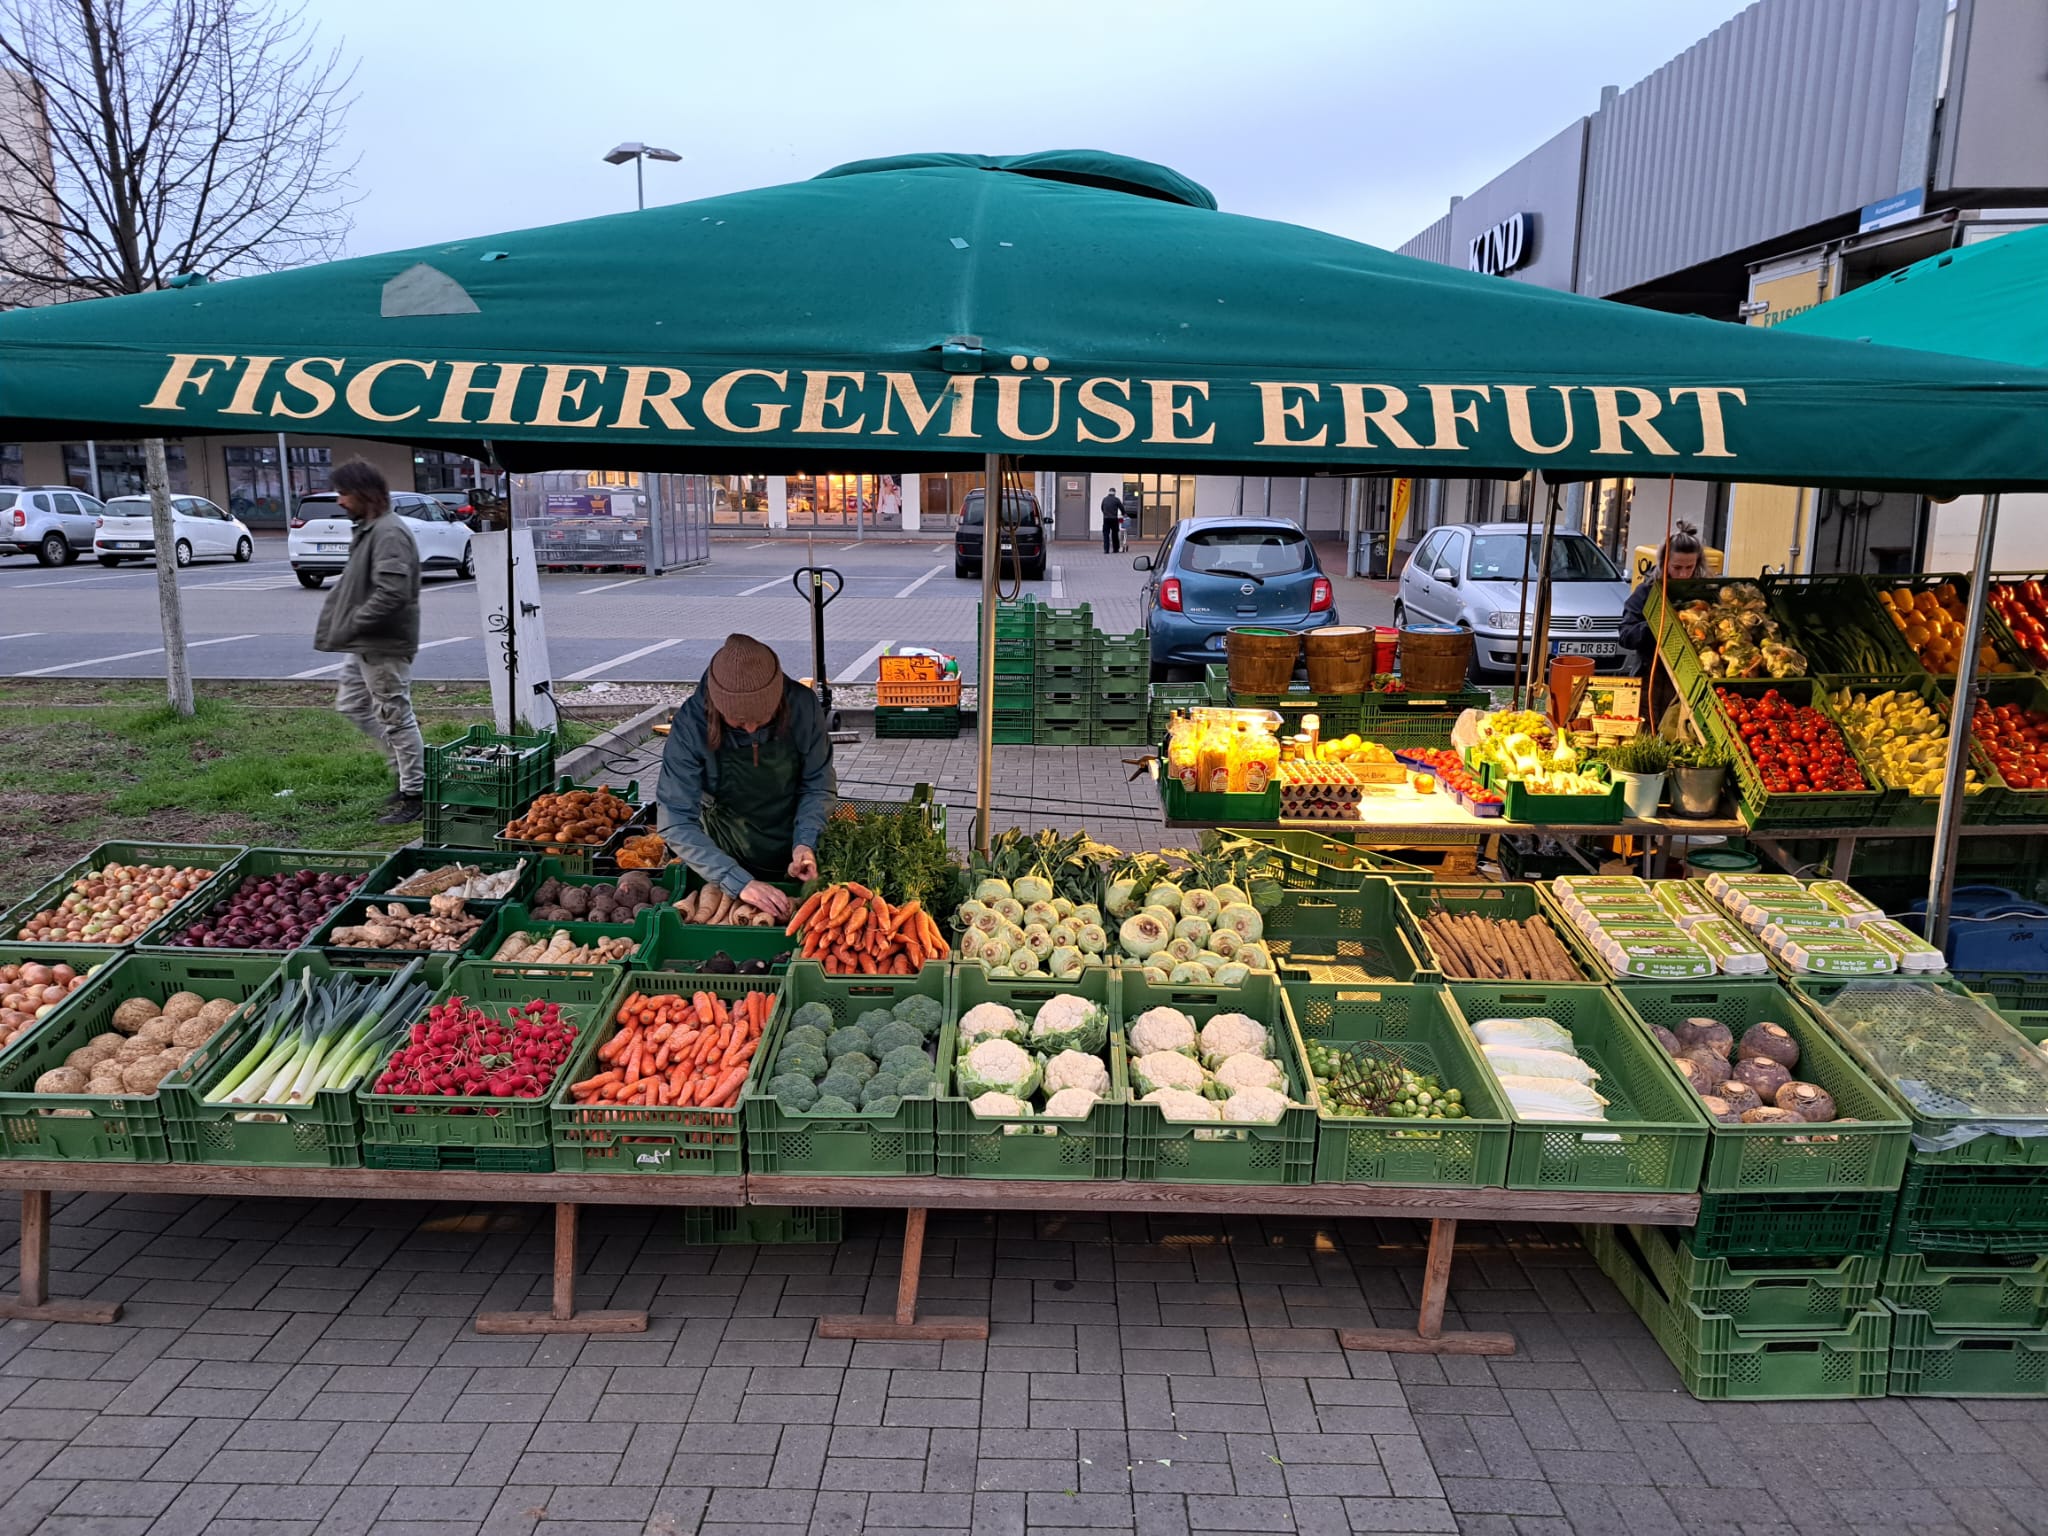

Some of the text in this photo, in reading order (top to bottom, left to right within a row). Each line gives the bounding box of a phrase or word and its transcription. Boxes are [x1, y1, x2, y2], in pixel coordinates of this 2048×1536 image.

[1469, 211, 1523, 276] KIND
[140, 353, 1747, 459] FISCHERGEMÜSE ERFURT
[1559, 643, 1616, 654] EF DR 833
